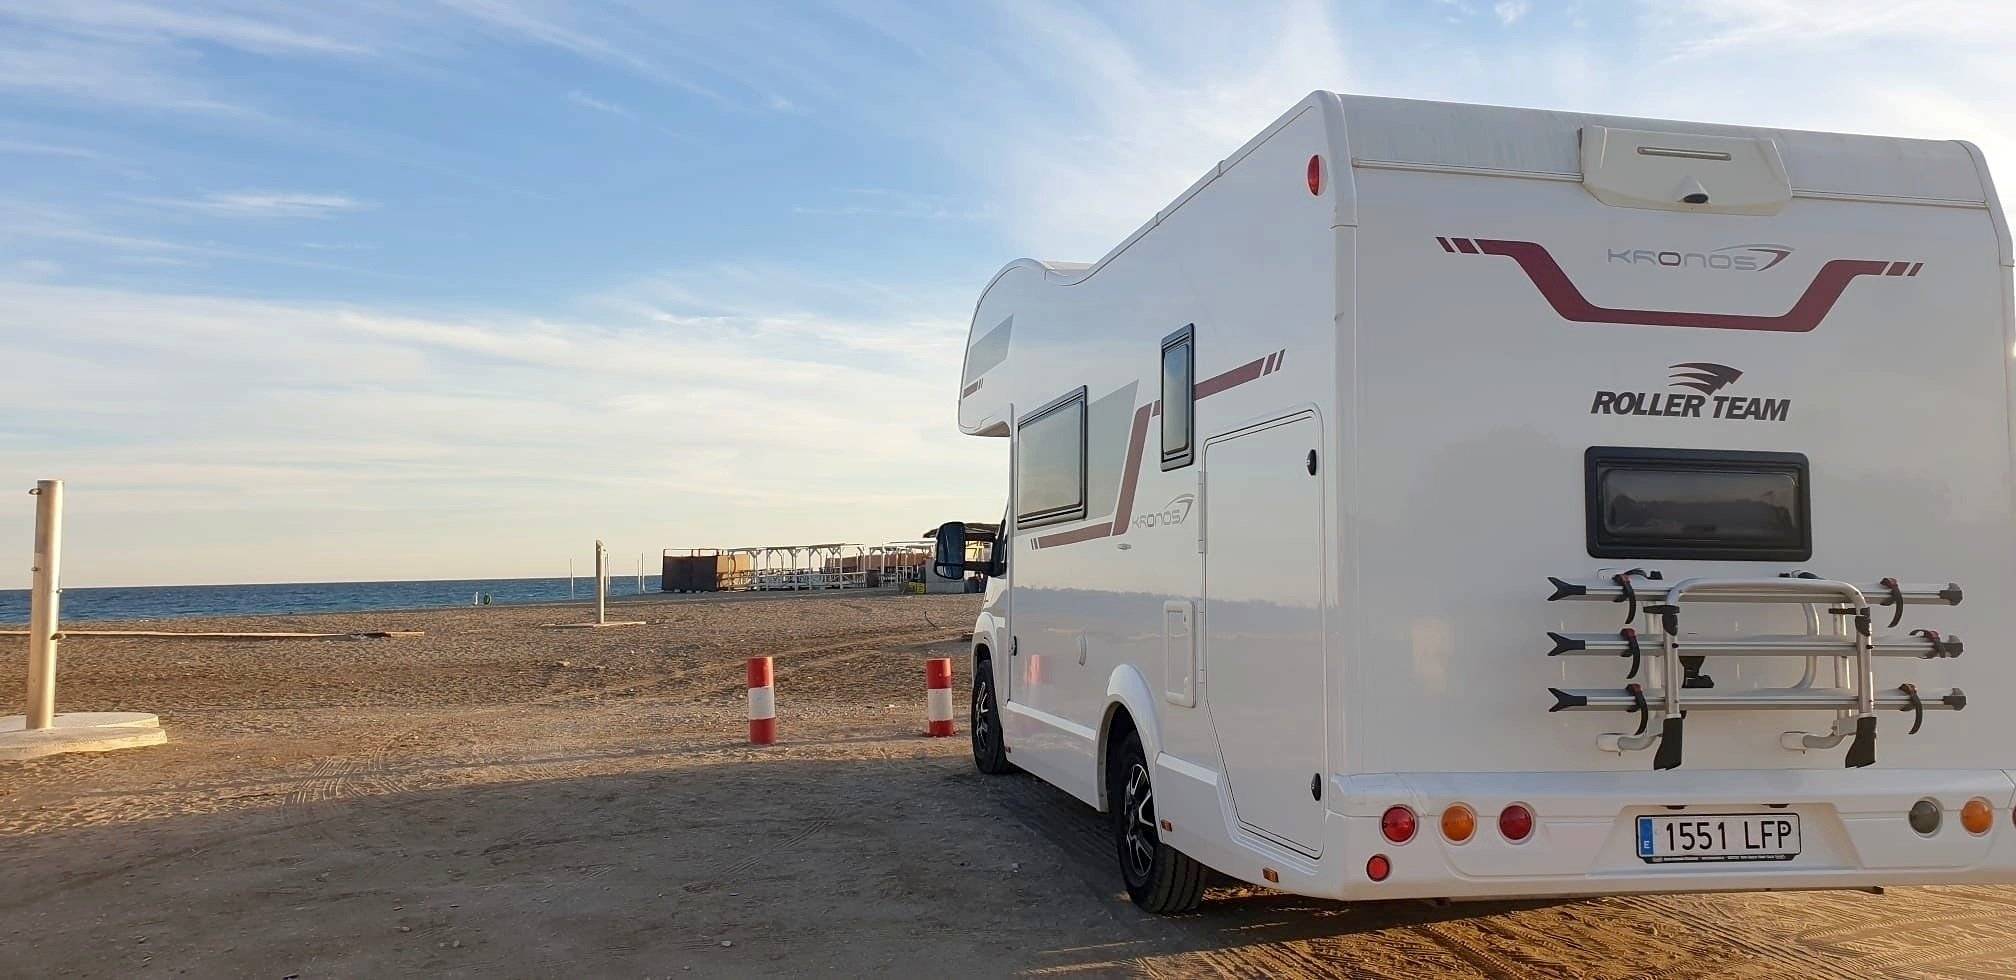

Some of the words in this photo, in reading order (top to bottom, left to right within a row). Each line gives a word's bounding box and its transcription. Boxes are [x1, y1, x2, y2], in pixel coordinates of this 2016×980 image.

[1607, 248, 1758, 271] KRONOS
[1591, 390, 1705, 418] ROLLER
[1711, 397, 1791, 421] TEAM
[1643, 840, 1651, 849] E
[1666, 822, 1727, 851] 1551
[1744, 820, 1792, 849] LFP
